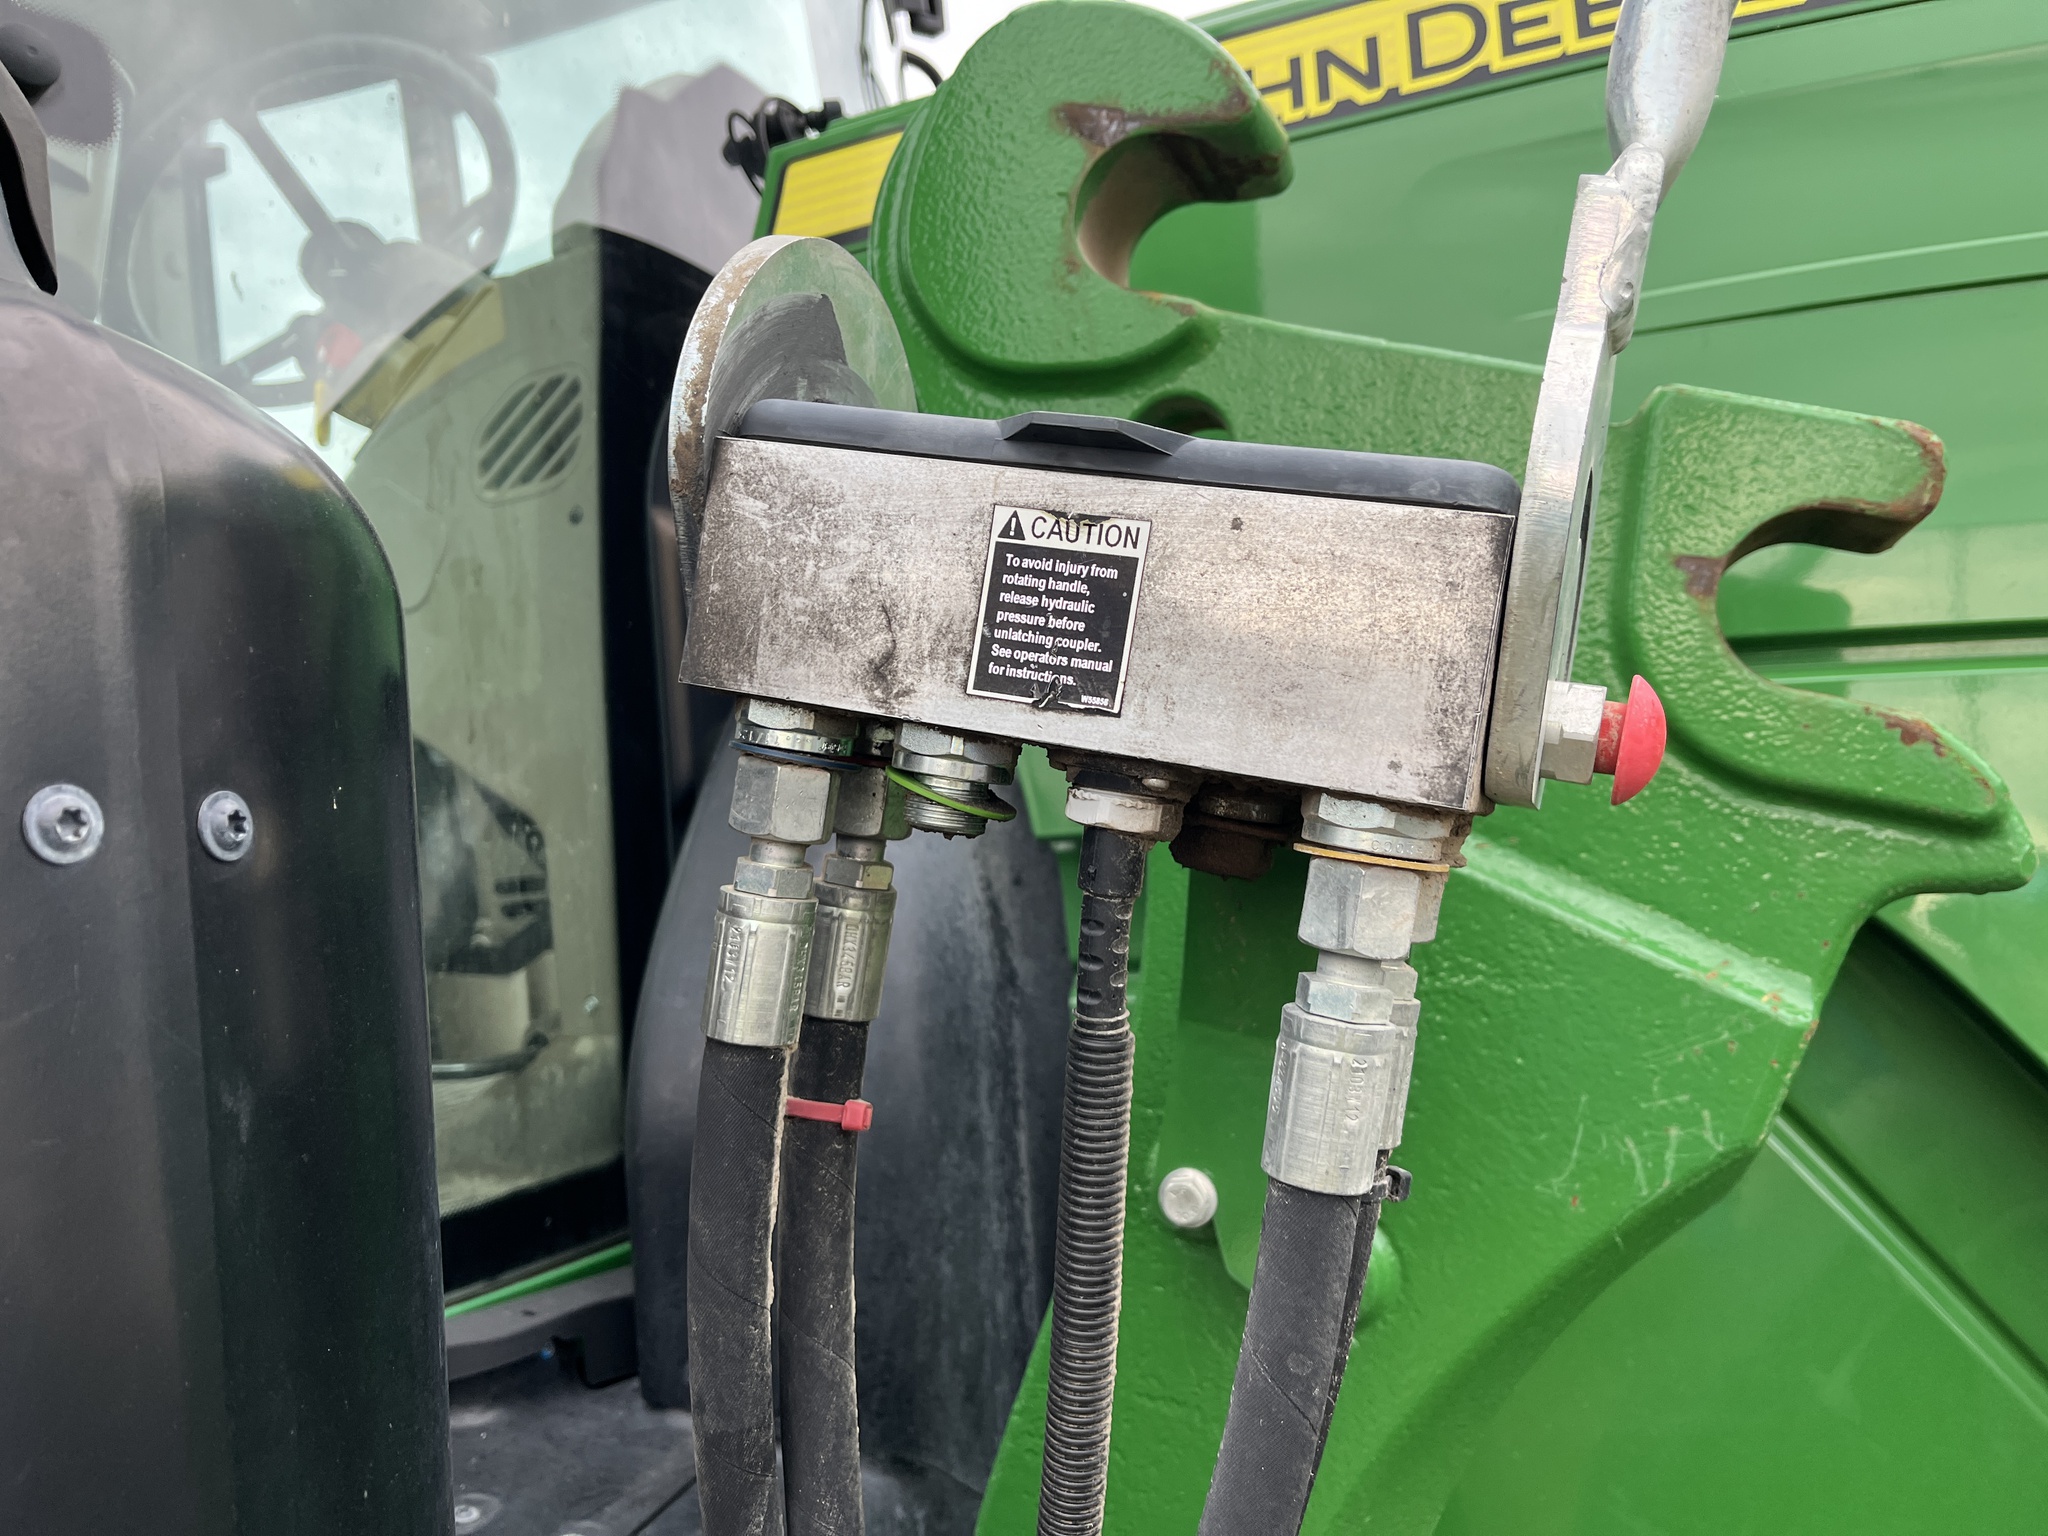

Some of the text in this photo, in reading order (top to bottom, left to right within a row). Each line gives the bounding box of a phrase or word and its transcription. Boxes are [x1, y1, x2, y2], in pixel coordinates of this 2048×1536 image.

[1246, 0, 1625, 109] HN DEE
[1031, 516, 1141, 549] CAUTION
[1005, 553, 1119, 579] To avoid injury from
[1002, 573, 1091, 596] rotating handle,
[999, 590, 1096, 614] release hydraulic
[995, 610, 1086, 632] pressure before
[993, 627, 1102, 653] unlatching coupler.
[988, 661, 1005, 675] for
[991, 643, 1114, 673] See operators manual
